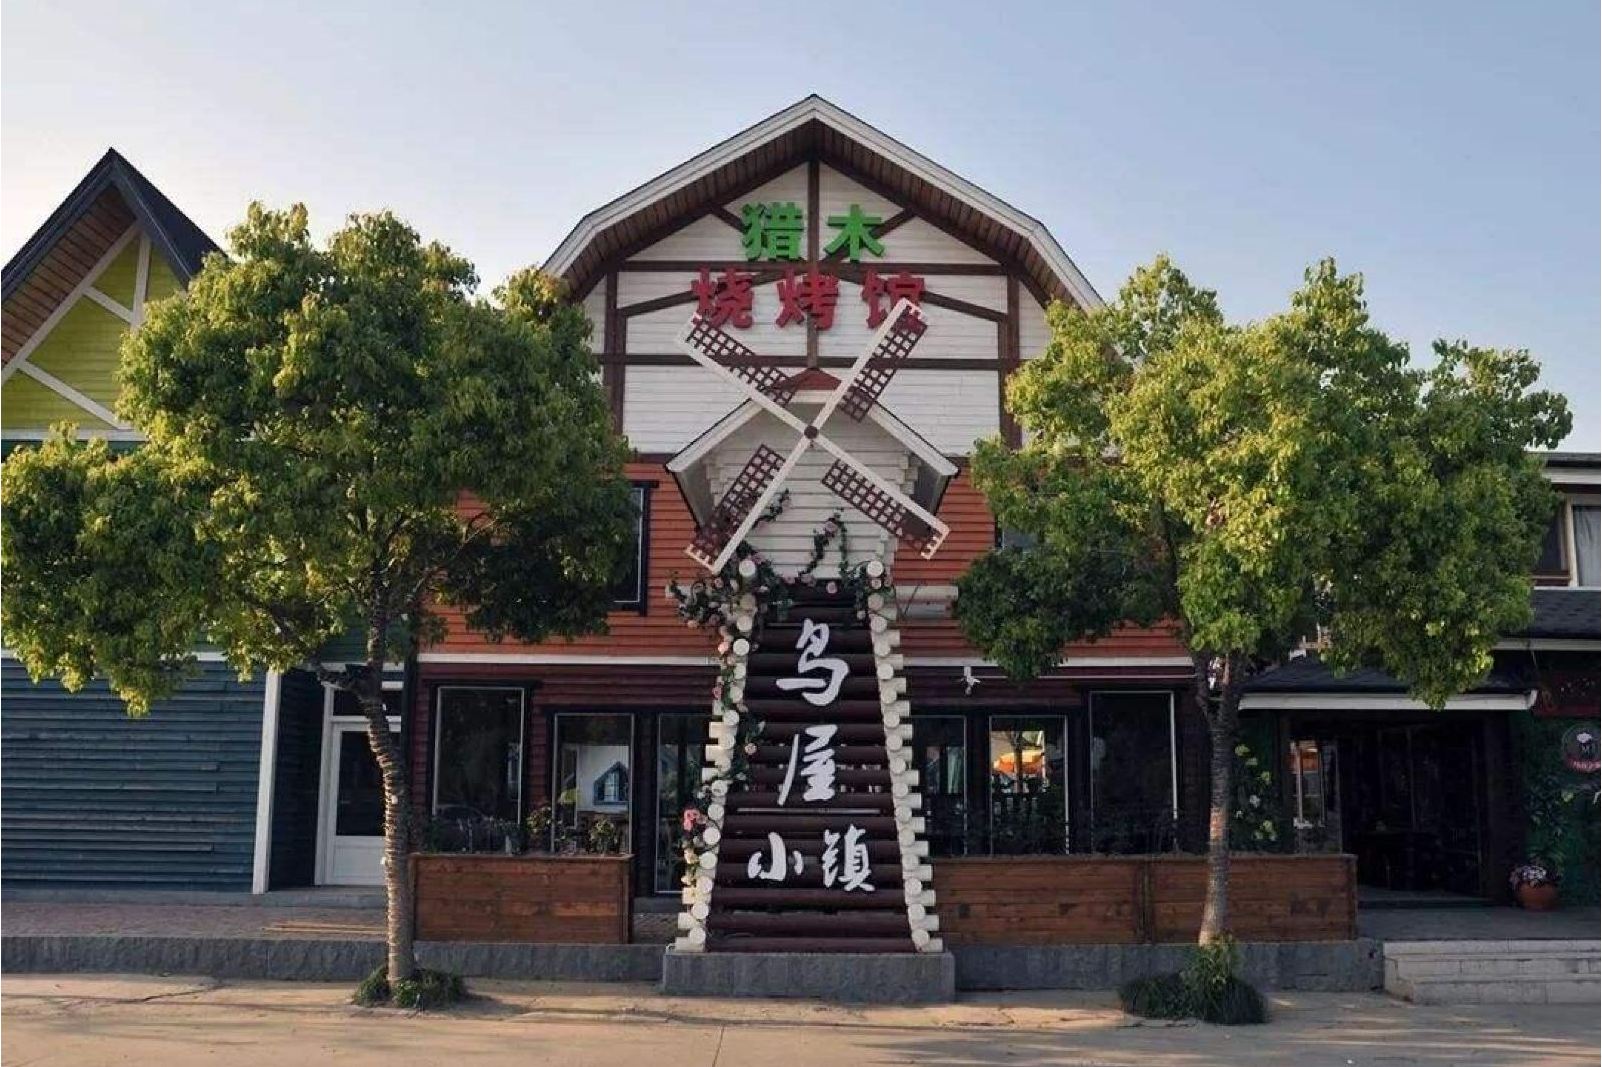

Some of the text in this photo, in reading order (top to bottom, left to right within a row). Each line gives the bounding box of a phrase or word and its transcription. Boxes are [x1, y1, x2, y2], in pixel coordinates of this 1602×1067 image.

[741, 202, 886, 262] 猎木
[691, 265, 926, 331] 烧烤馆
[747, 824, 876, 892] 小镇
